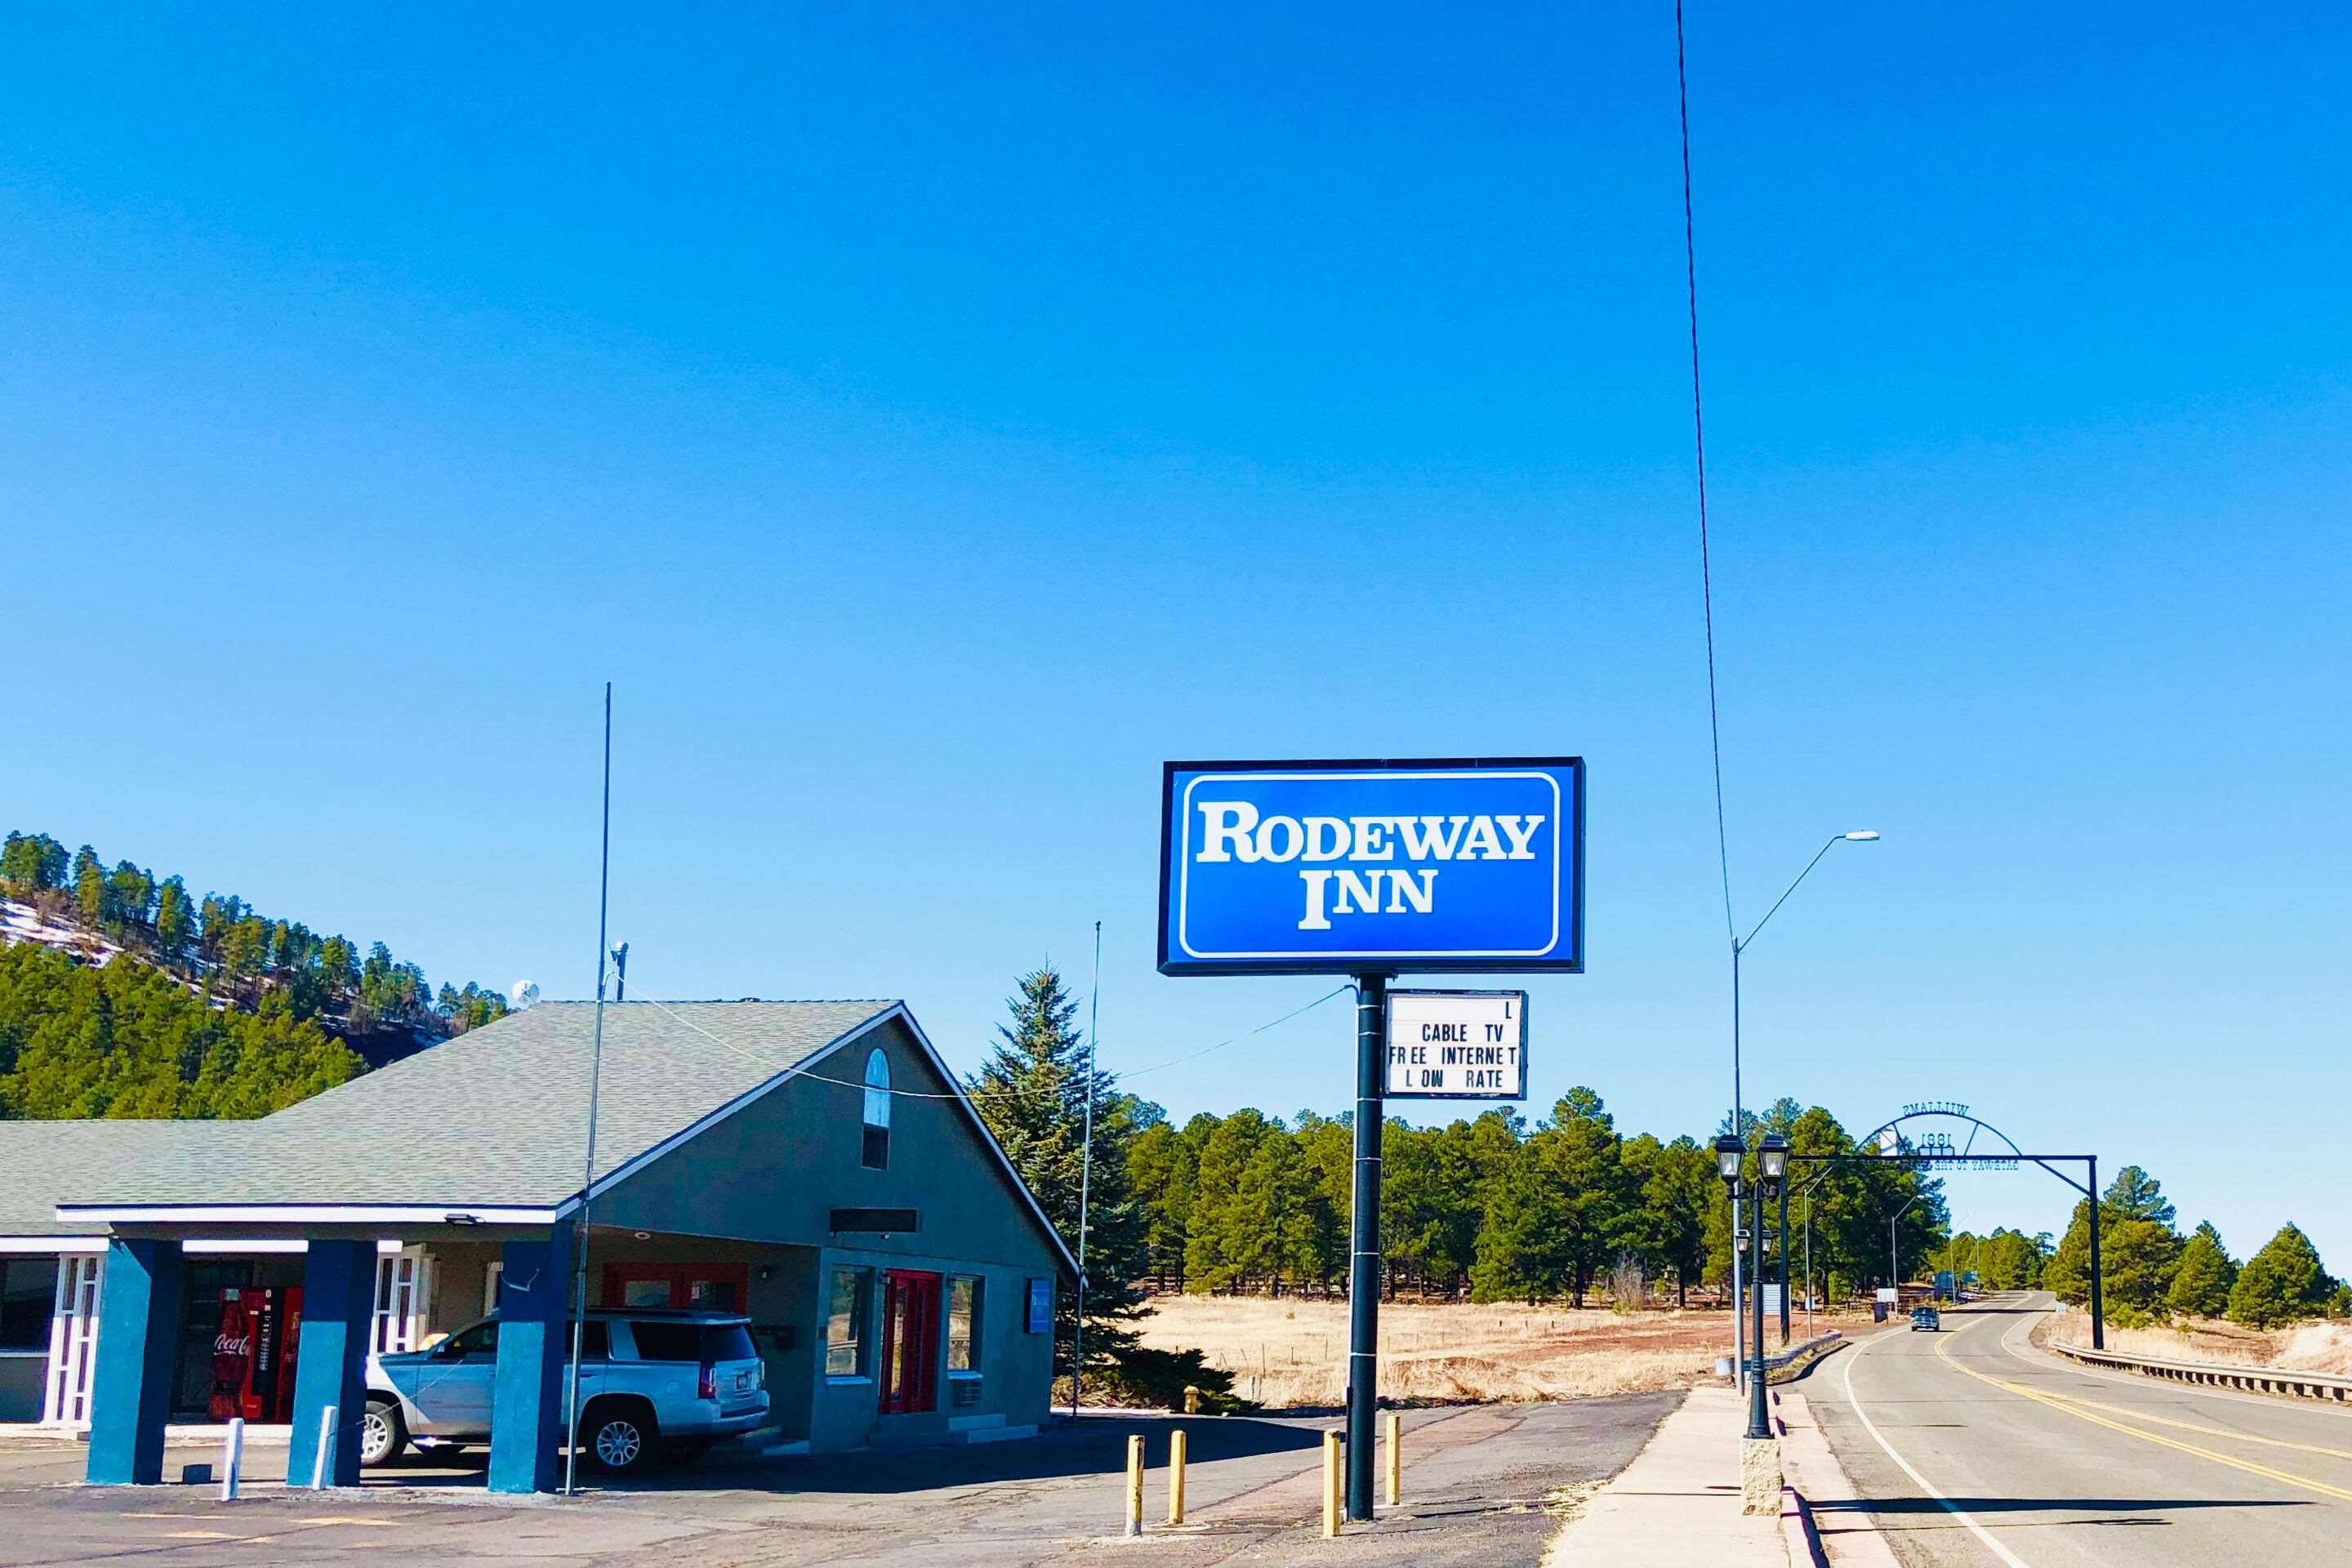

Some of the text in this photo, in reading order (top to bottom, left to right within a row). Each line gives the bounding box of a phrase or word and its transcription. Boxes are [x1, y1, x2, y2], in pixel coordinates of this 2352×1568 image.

[1196, 800, 1545, 863] RODEWAY
[1298, 869, 1439, 930] INN
[1505, 1001, 1512, 1019] L
[1422, 1023, 1503, 1042] CABLE TV
[1389, 1046, 1517, 1065] FREE INTERNET
[1405, 1069, 1503, 1088] LOW RATE
